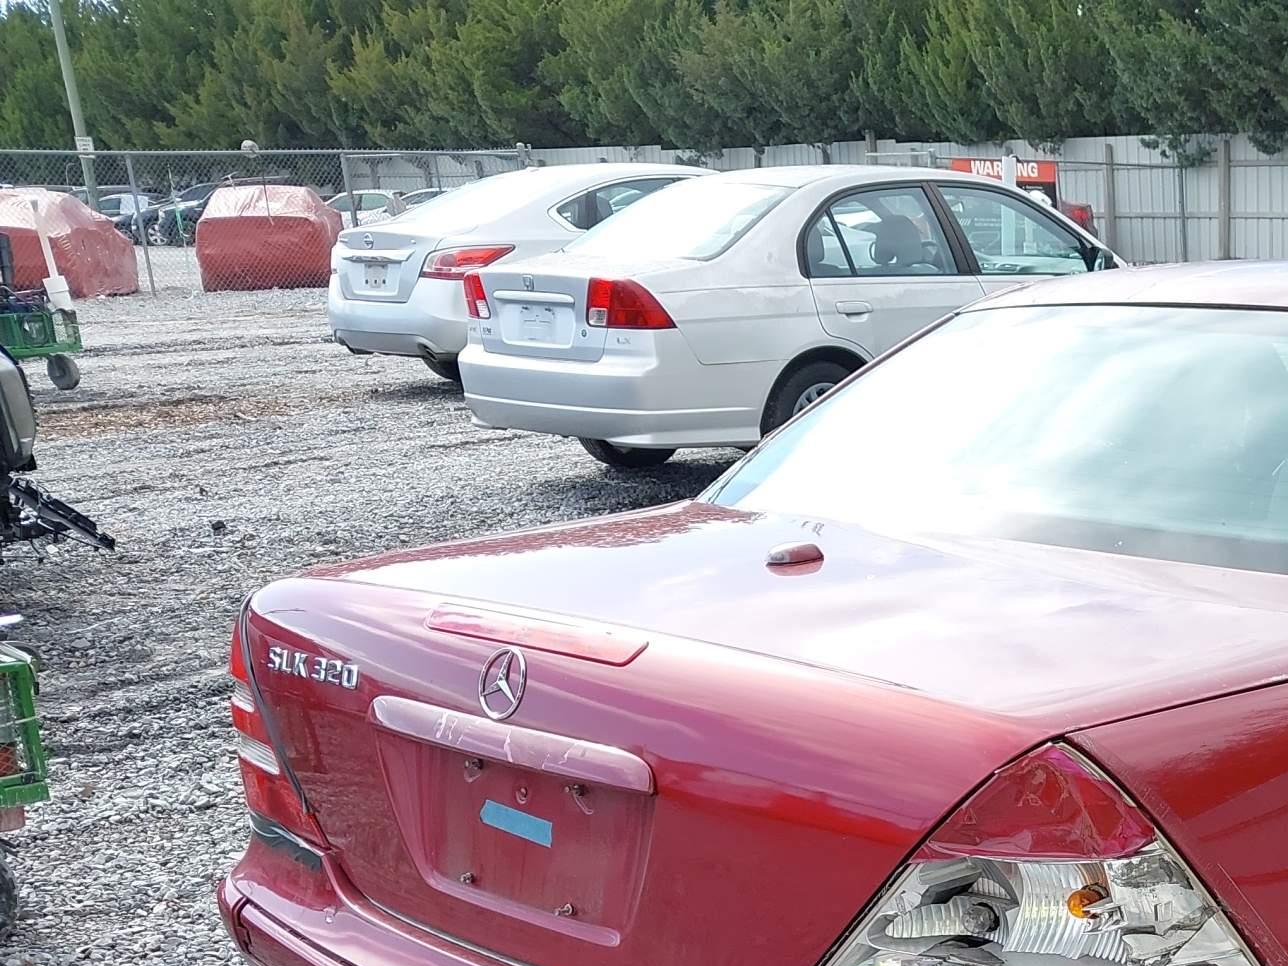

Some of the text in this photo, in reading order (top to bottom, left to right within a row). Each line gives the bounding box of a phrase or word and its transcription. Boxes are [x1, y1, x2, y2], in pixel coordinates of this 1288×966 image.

[971, 160, 1038, 177] WARNG
[267, 646, 359, 690] SLK 320
